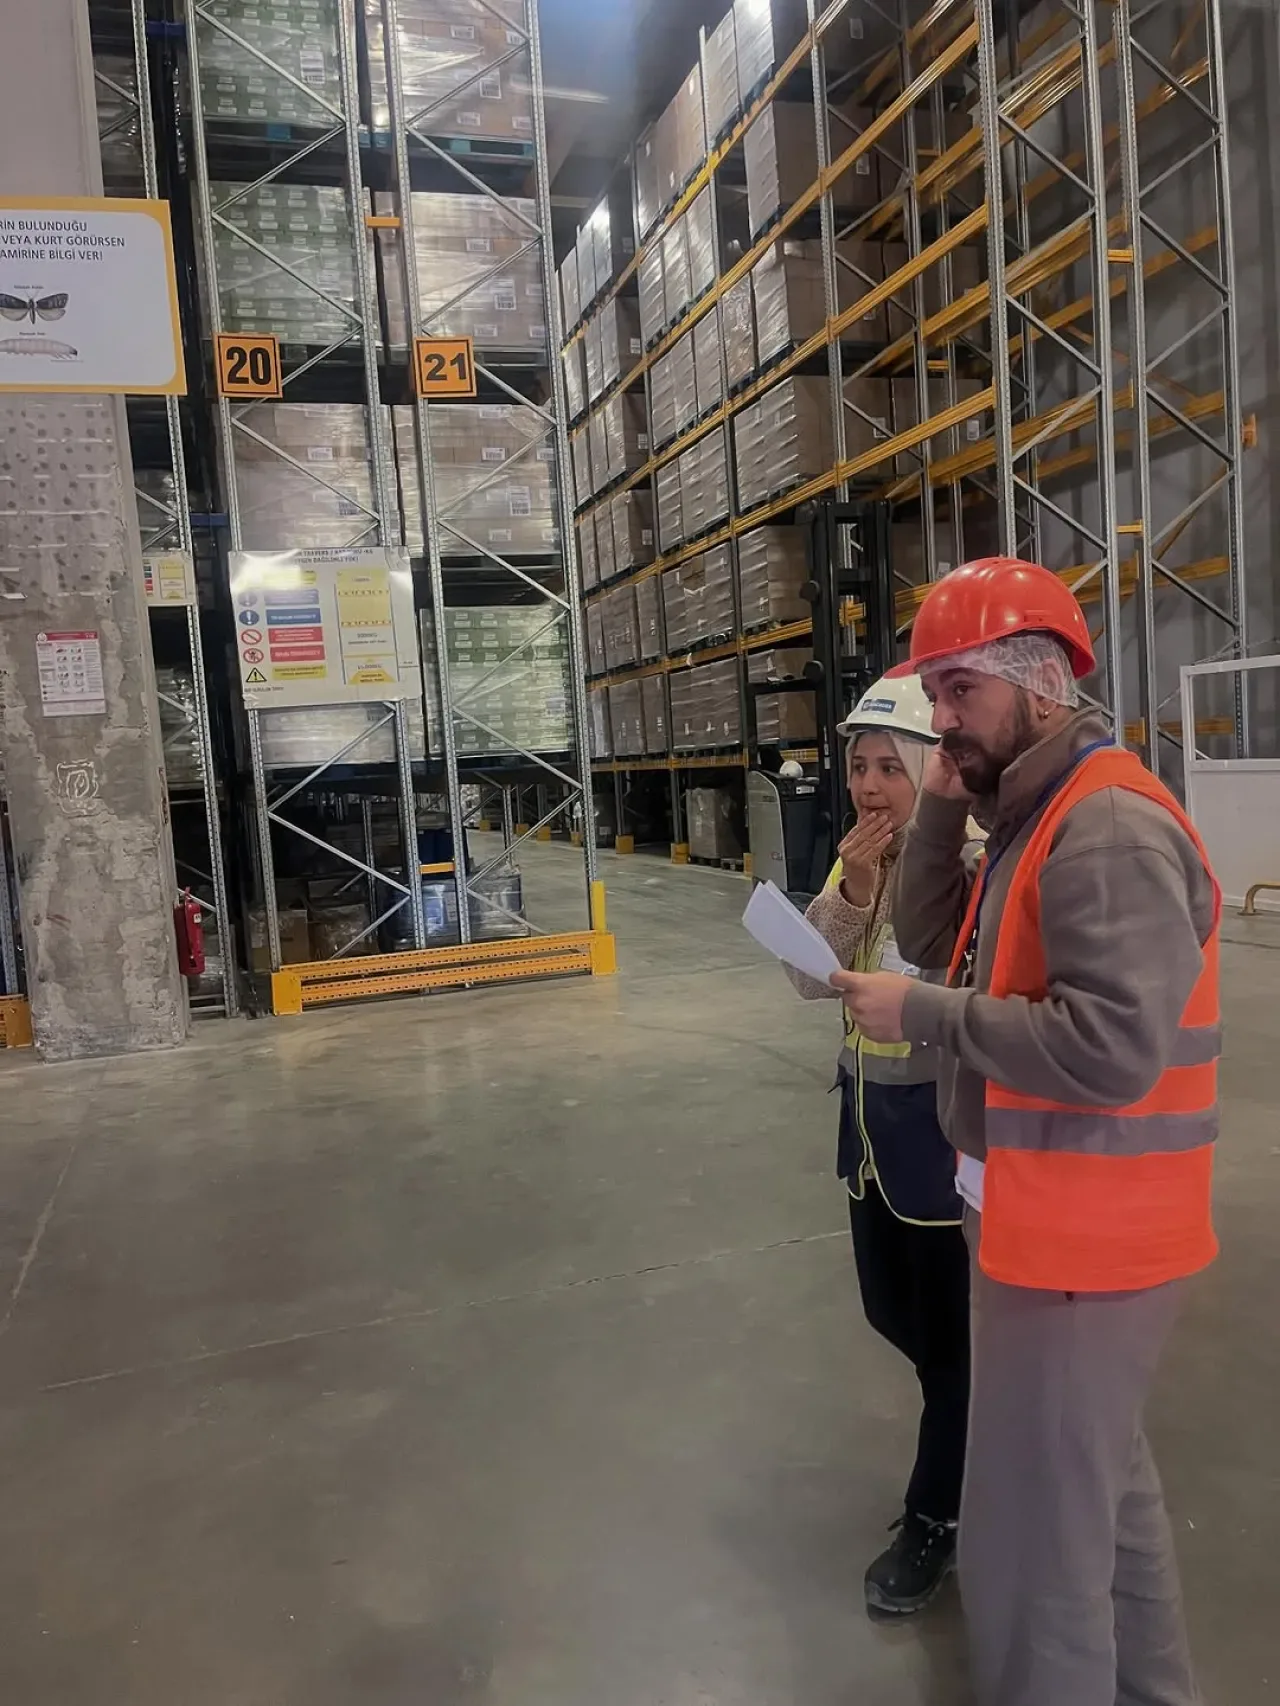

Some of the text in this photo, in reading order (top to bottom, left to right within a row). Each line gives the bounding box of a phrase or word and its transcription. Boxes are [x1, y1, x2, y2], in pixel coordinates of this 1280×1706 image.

[18, 219, 87, 231] BULUNDUĞU
[1, 234, 125, 247] VEYA KURT GÖRÜRSEN
[49, 248, 76, 260] BİLGİ
[226, 346, 271, 385] 20
[424, 353, 467, 381] 21
